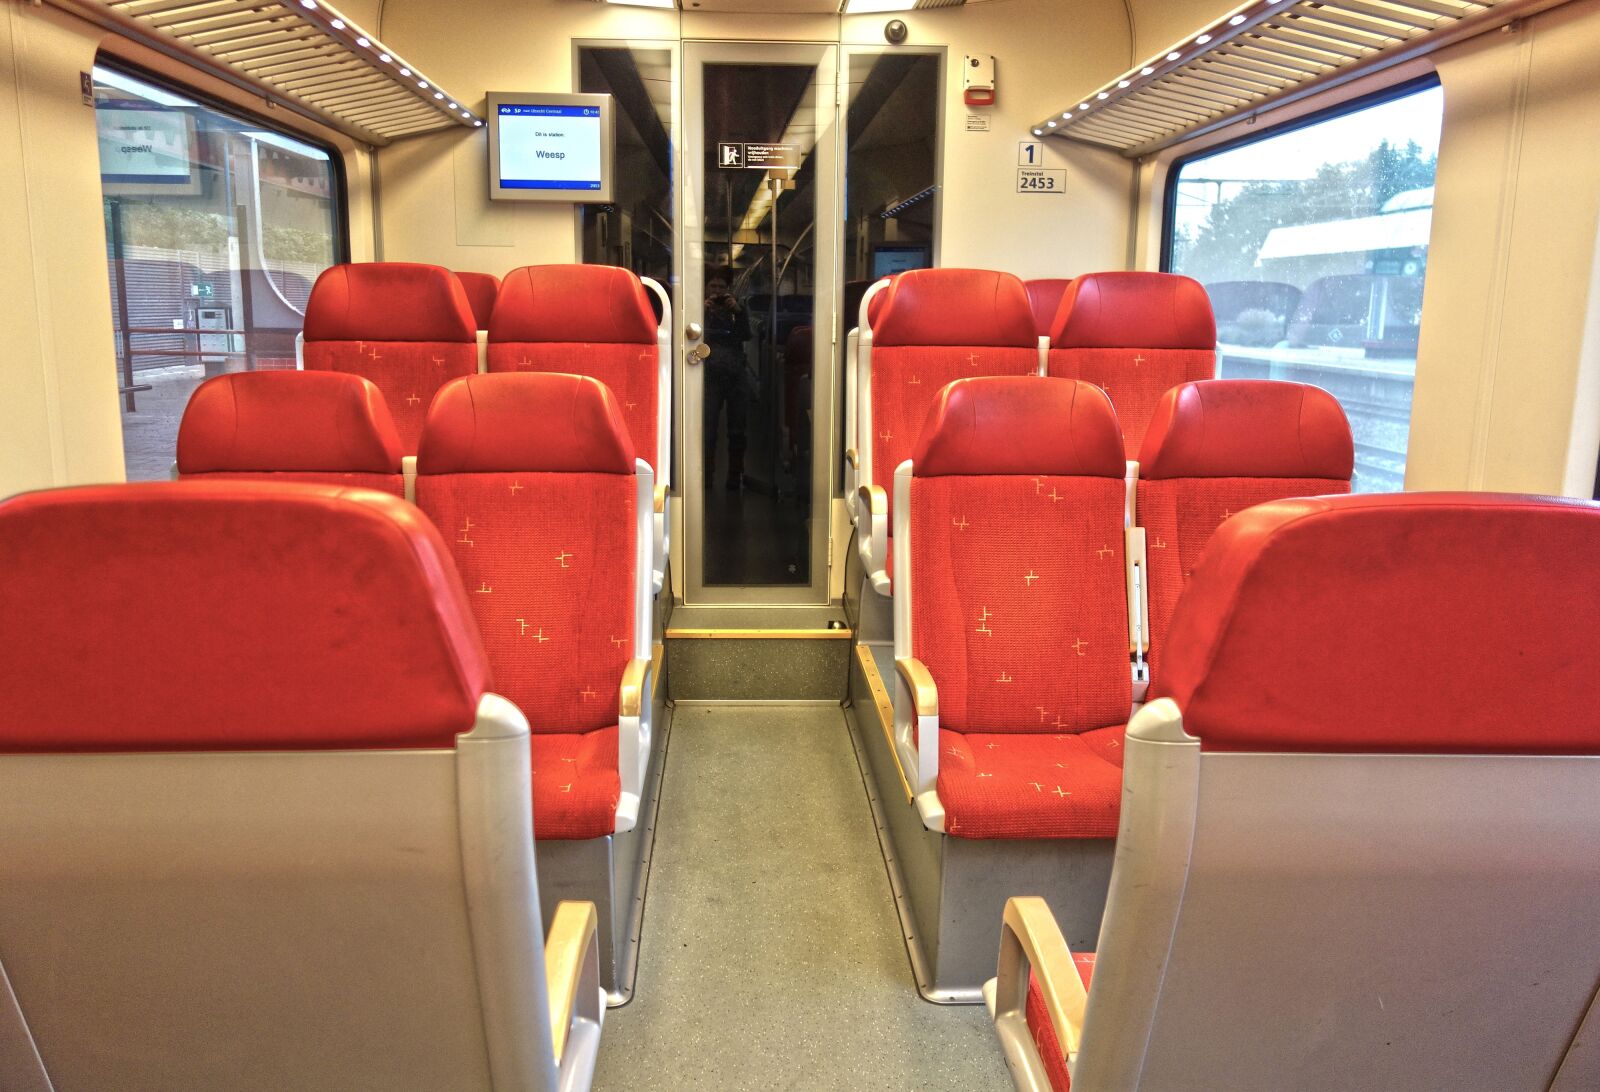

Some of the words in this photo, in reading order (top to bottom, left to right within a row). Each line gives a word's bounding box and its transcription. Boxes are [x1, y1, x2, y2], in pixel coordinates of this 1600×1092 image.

[535, 150, 565, 160] Weesp
[1025, 144, 1035, 164] 1
[1020, 177, 1054, 189] 2453
